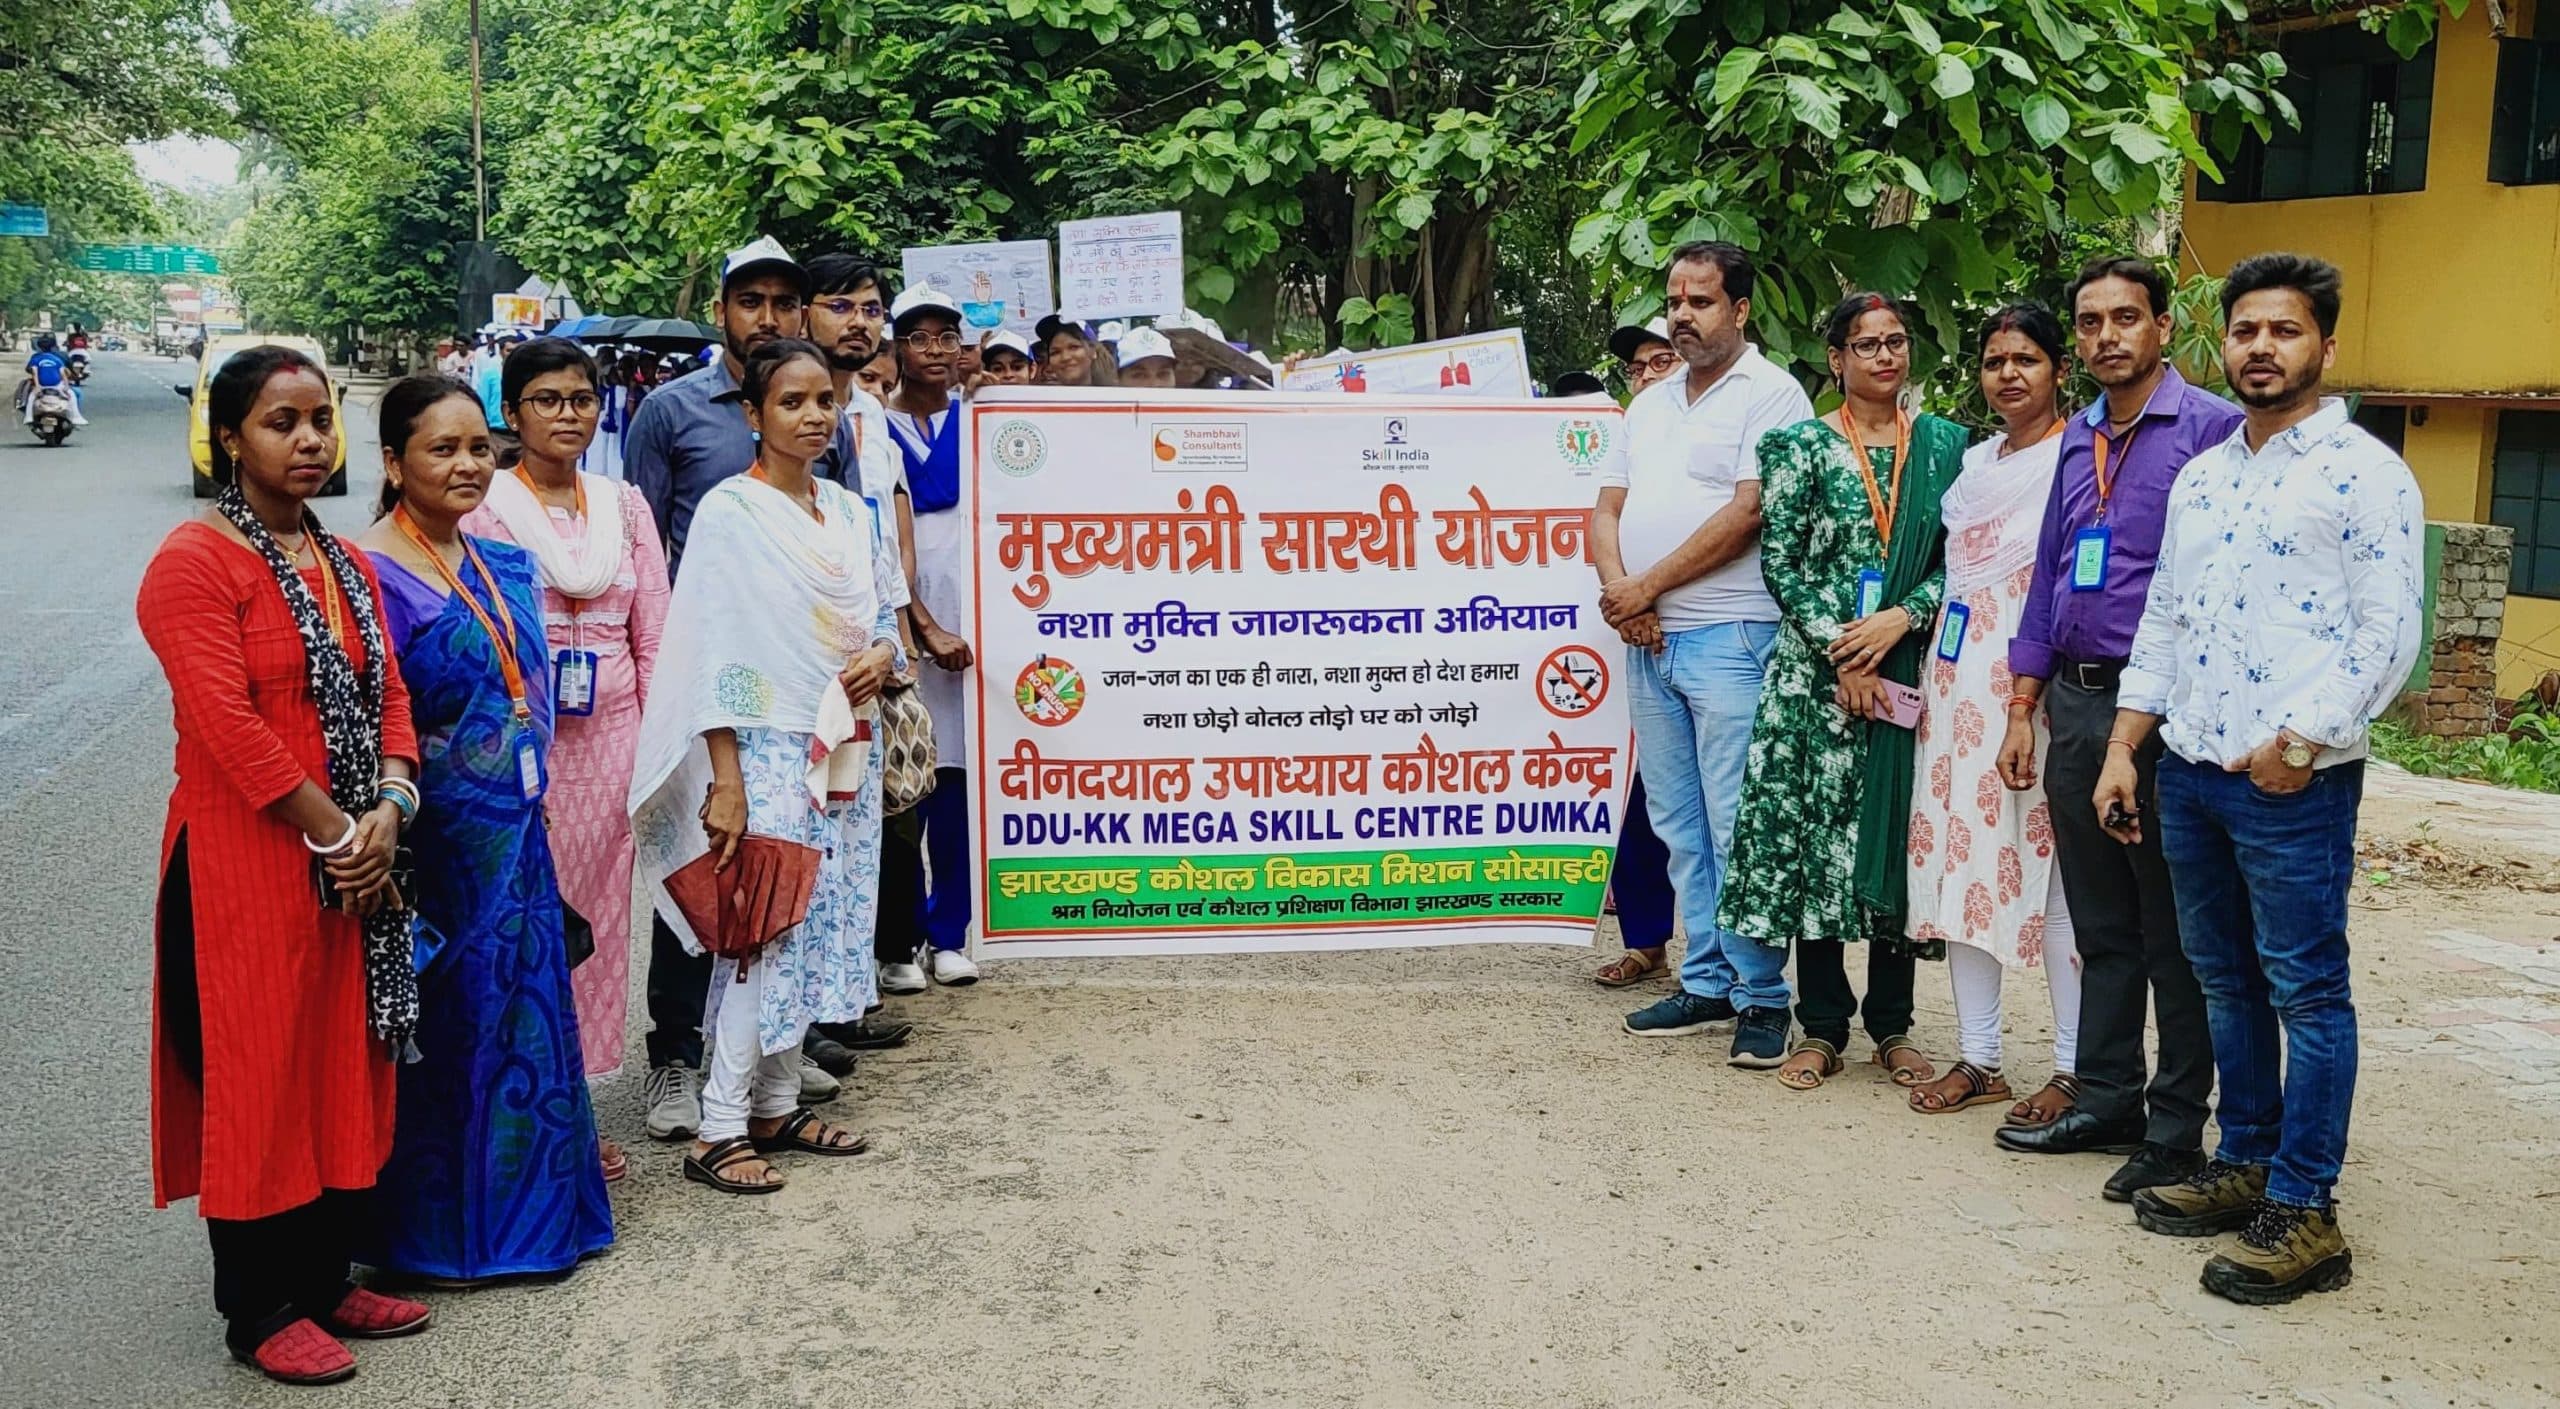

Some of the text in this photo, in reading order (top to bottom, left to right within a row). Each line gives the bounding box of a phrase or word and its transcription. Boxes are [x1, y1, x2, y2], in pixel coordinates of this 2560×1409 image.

[1182, 441, 1242, 450] Consultants
[1183, 429, 1240, 439] Shambhavi
[1362, 449, 1430, 461] Skill India
[996, 483, 1597, 611] मुख्यमंत्री सारथी योजन
[1037, 594, 1579, 653] नशा मुक्ति जागरूकता अभियान
[1027, 671, 1069, 716] NO DRUGS
[1102, 658, 1520, 692] जन-जन का एक ही नारा, नशा मुक्त हो देश हमारा
[1143, 701, 1479, 733] नशा छोड़ो बोतल तोड़ो घर को जोड़ो
[998, 730, 1617, 803] दीनदयाल उपाध्याय कौशल केन्द्र
[1003, 801, 1612, 846] DDU-KK MEGA SKILL CENTRE DUMKA
[998, 849, 1610, 899] झारखण्ड कौशल विकास मिशन सोसाइटी
[1051, 891, 1565, 920] श्रम नियोजन एवं कौशल प्रशिक्षण विभाग झारखण्ड सरकार
